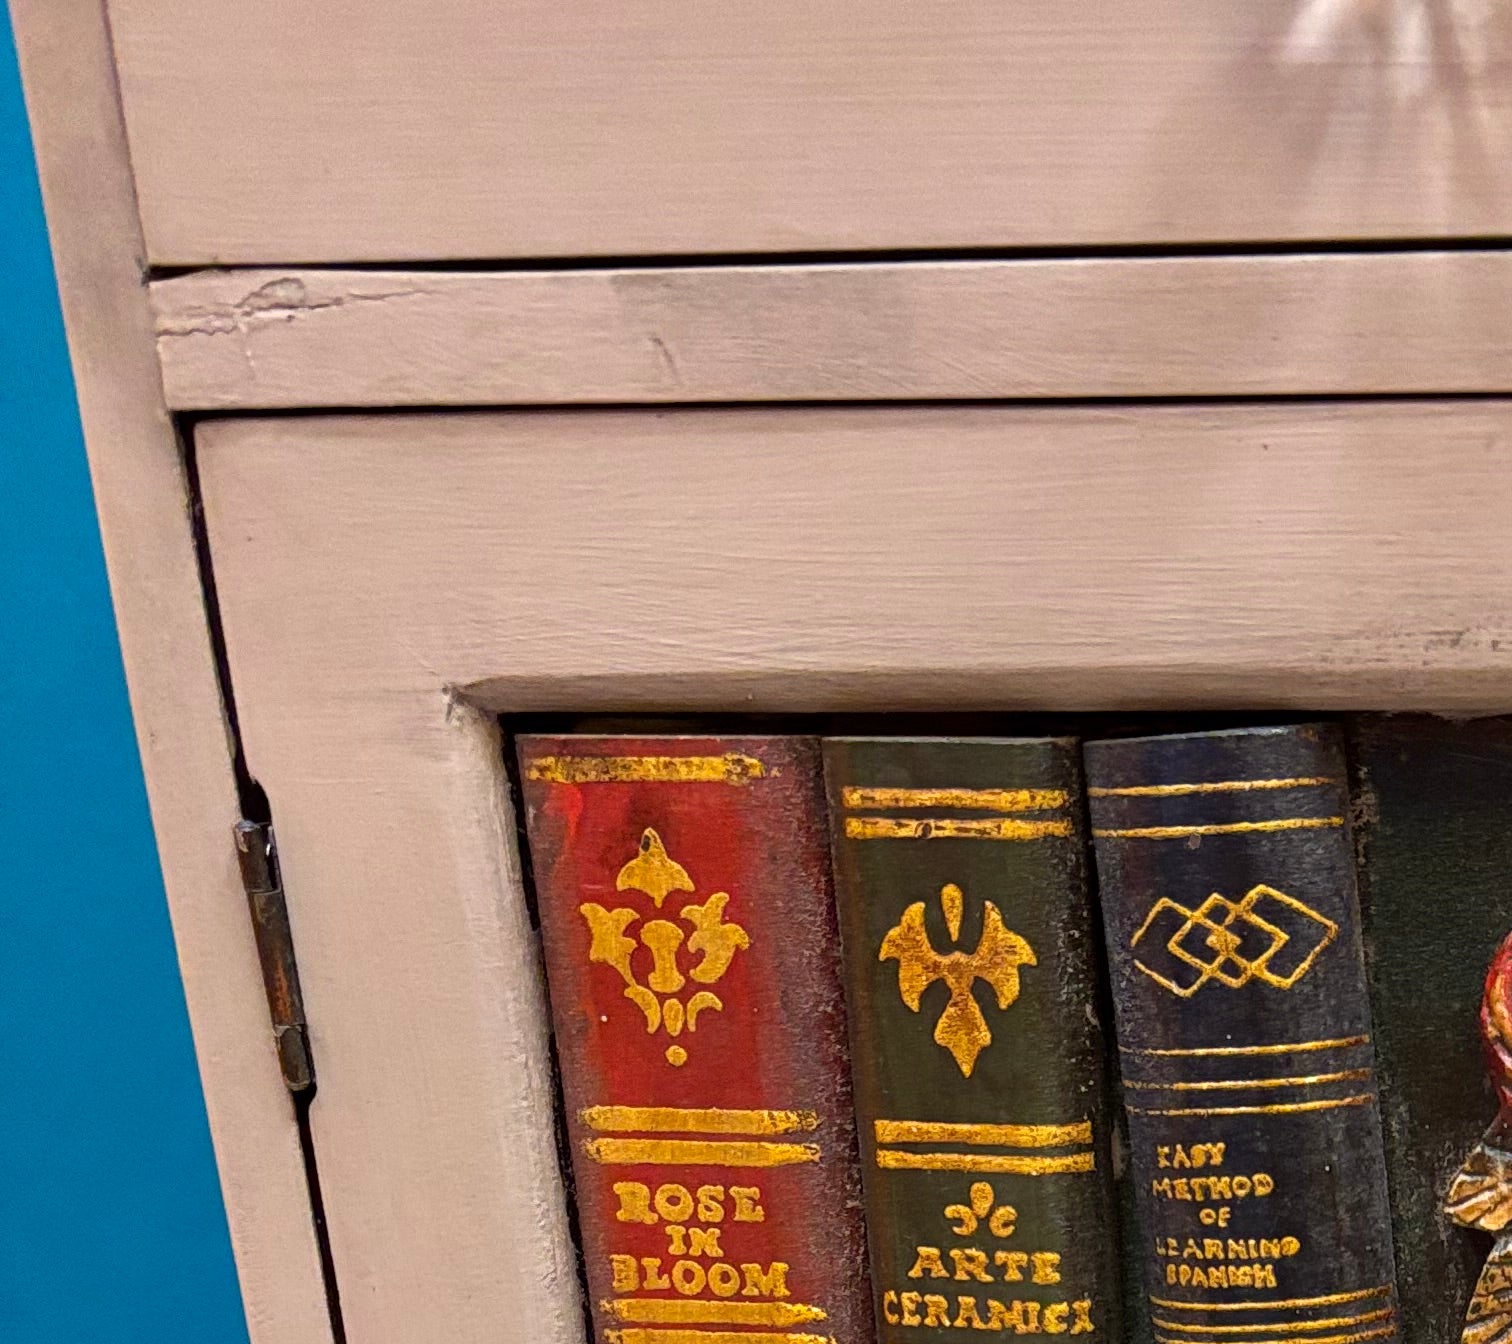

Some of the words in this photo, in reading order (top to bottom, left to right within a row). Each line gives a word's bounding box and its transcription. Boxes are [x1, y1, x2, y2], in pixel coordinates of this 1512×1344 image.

[613, 1181, 765, 1225] ROSE
[1152, 1172, 1274, 1201] METHOD
[1199, 1206, 1231, 1227] OF
[665, 1225, 724, 1257] IN
[610, 1254, 791, 1298] BLOOM
[907, 1246, 1061, 1285] ARTE
